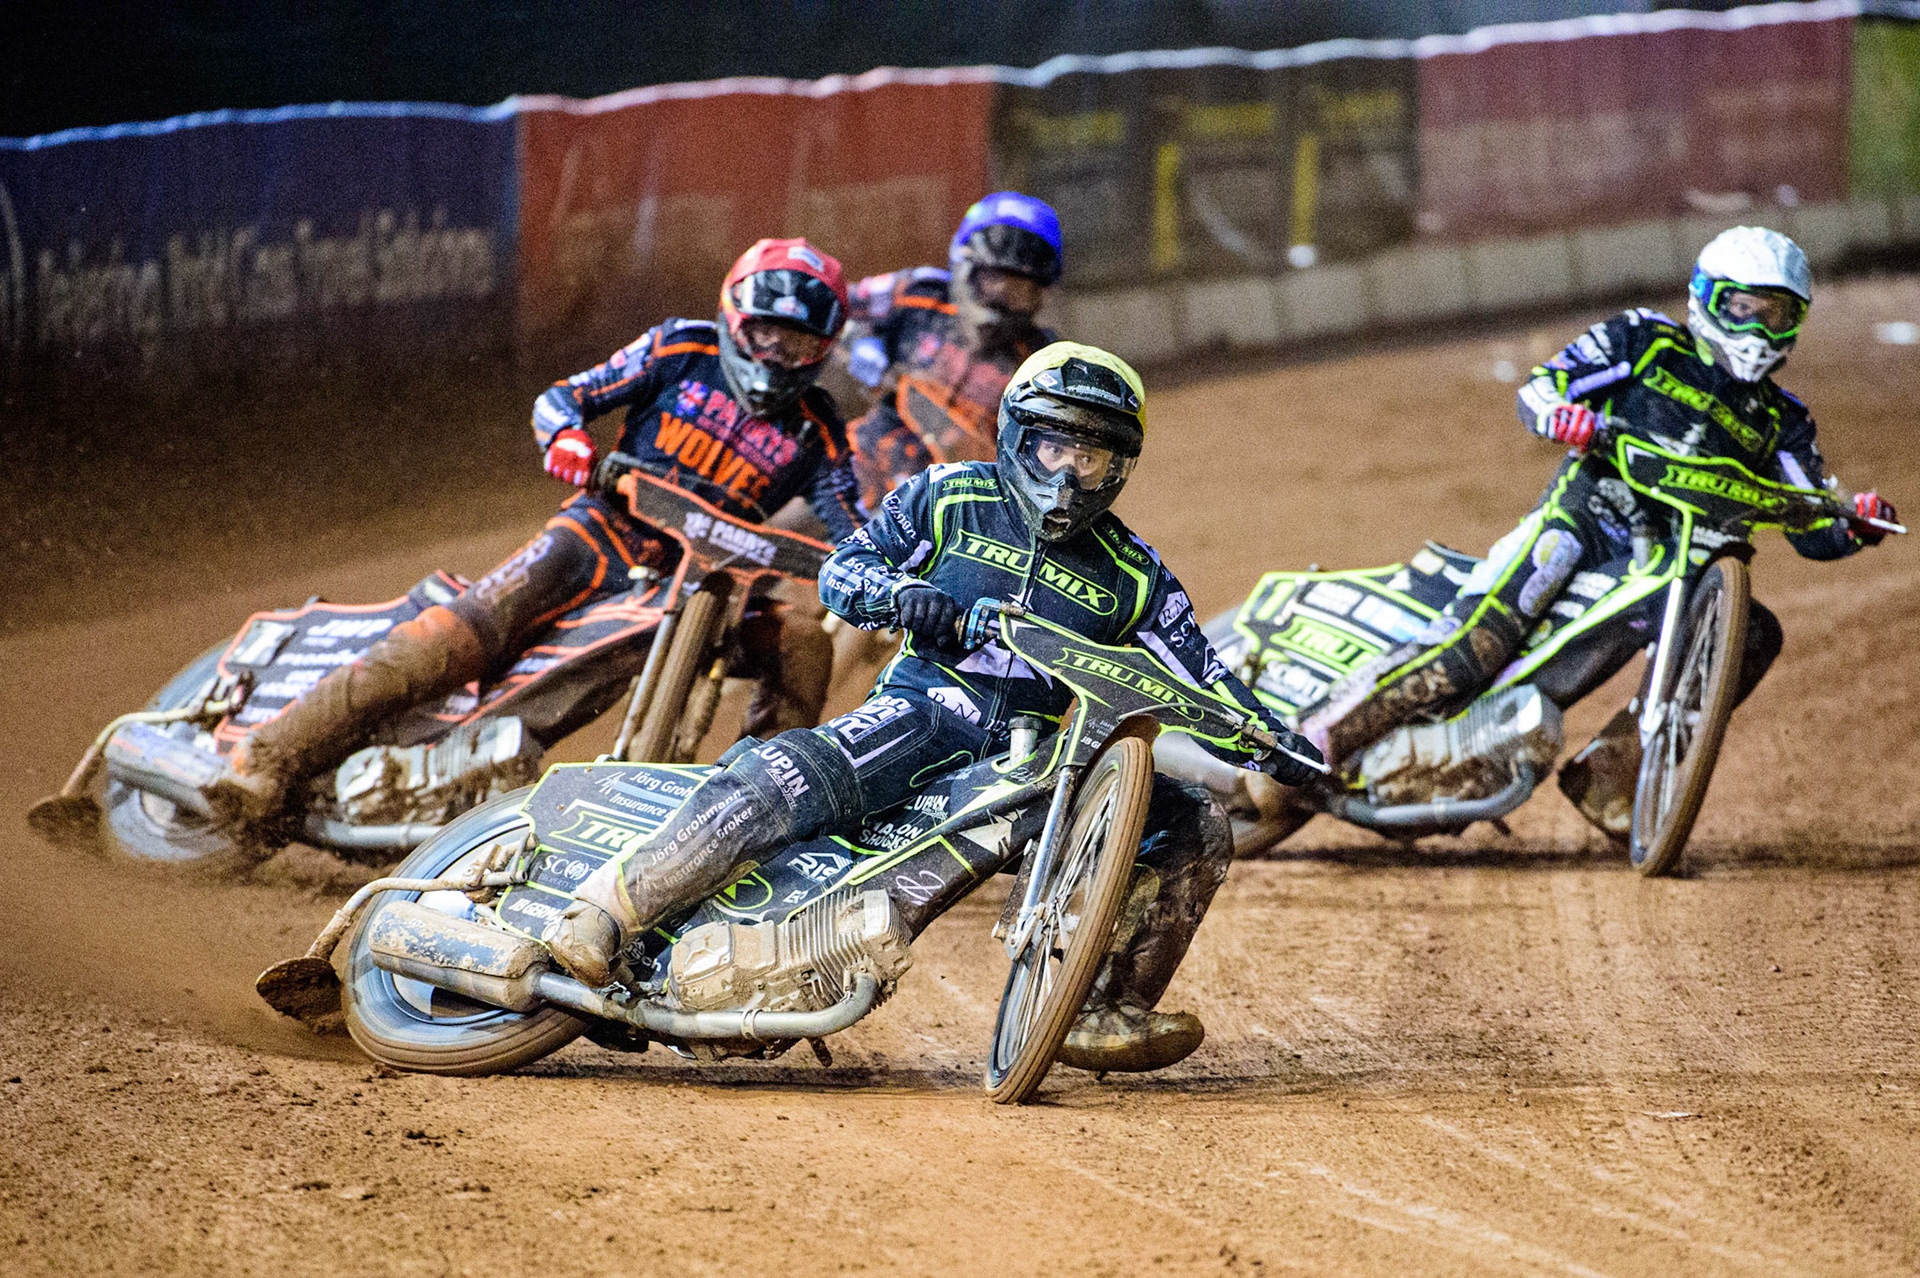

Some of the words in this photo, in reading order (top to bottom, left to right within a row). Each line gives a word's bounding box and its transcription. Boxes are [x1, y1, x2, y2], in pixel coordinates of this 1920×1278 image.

[966, 538, 1032, 571] TRU
[1039, 562, 1108, 609] MIX
[1072, 654, 1134, 682] TRU
[1135, 677, 1189, 715] MIX
[609, 793, 667, 818] Insurance
[630, 771, 659, 791] Jörg
[660, 780, 695, 798] Groh
[650, 839, 679, 865] Jörg
[676, 789, 743, 842] Grohmann
[664, 838, 720, 887] Insurance
[716, 805, 754, 839] Broker
